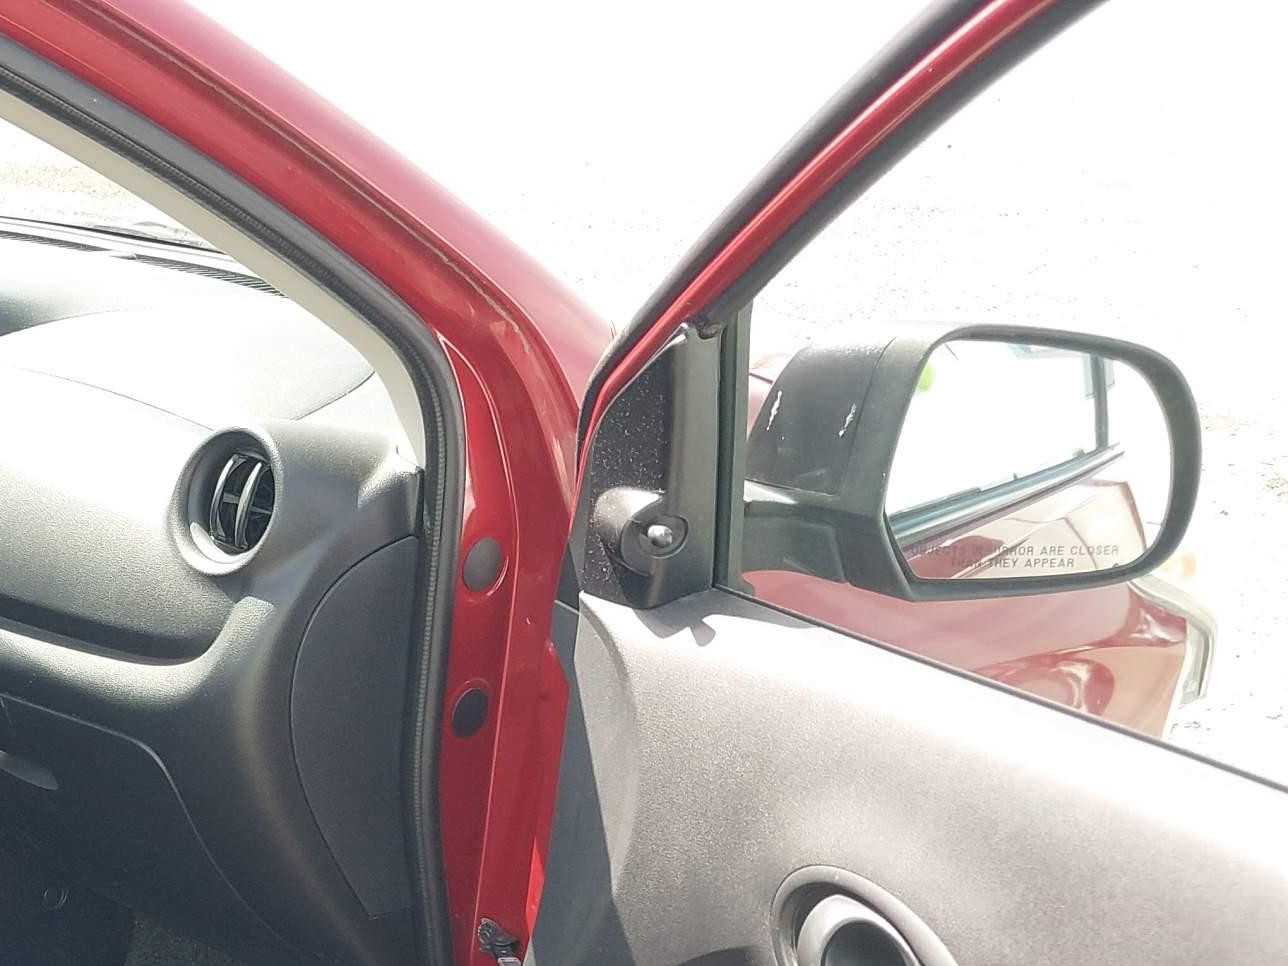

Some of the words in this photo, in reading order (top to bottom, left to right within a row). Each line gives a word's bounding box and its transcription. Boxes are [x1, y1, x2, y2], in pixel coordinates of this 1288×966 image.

[1040, 545, 1065, 556] ARE
[1070, 545, 1120, 556] CLOSER
[989, 558, 1019, 569] THEY
[1024, 558, 1075, 568] APPEAR
